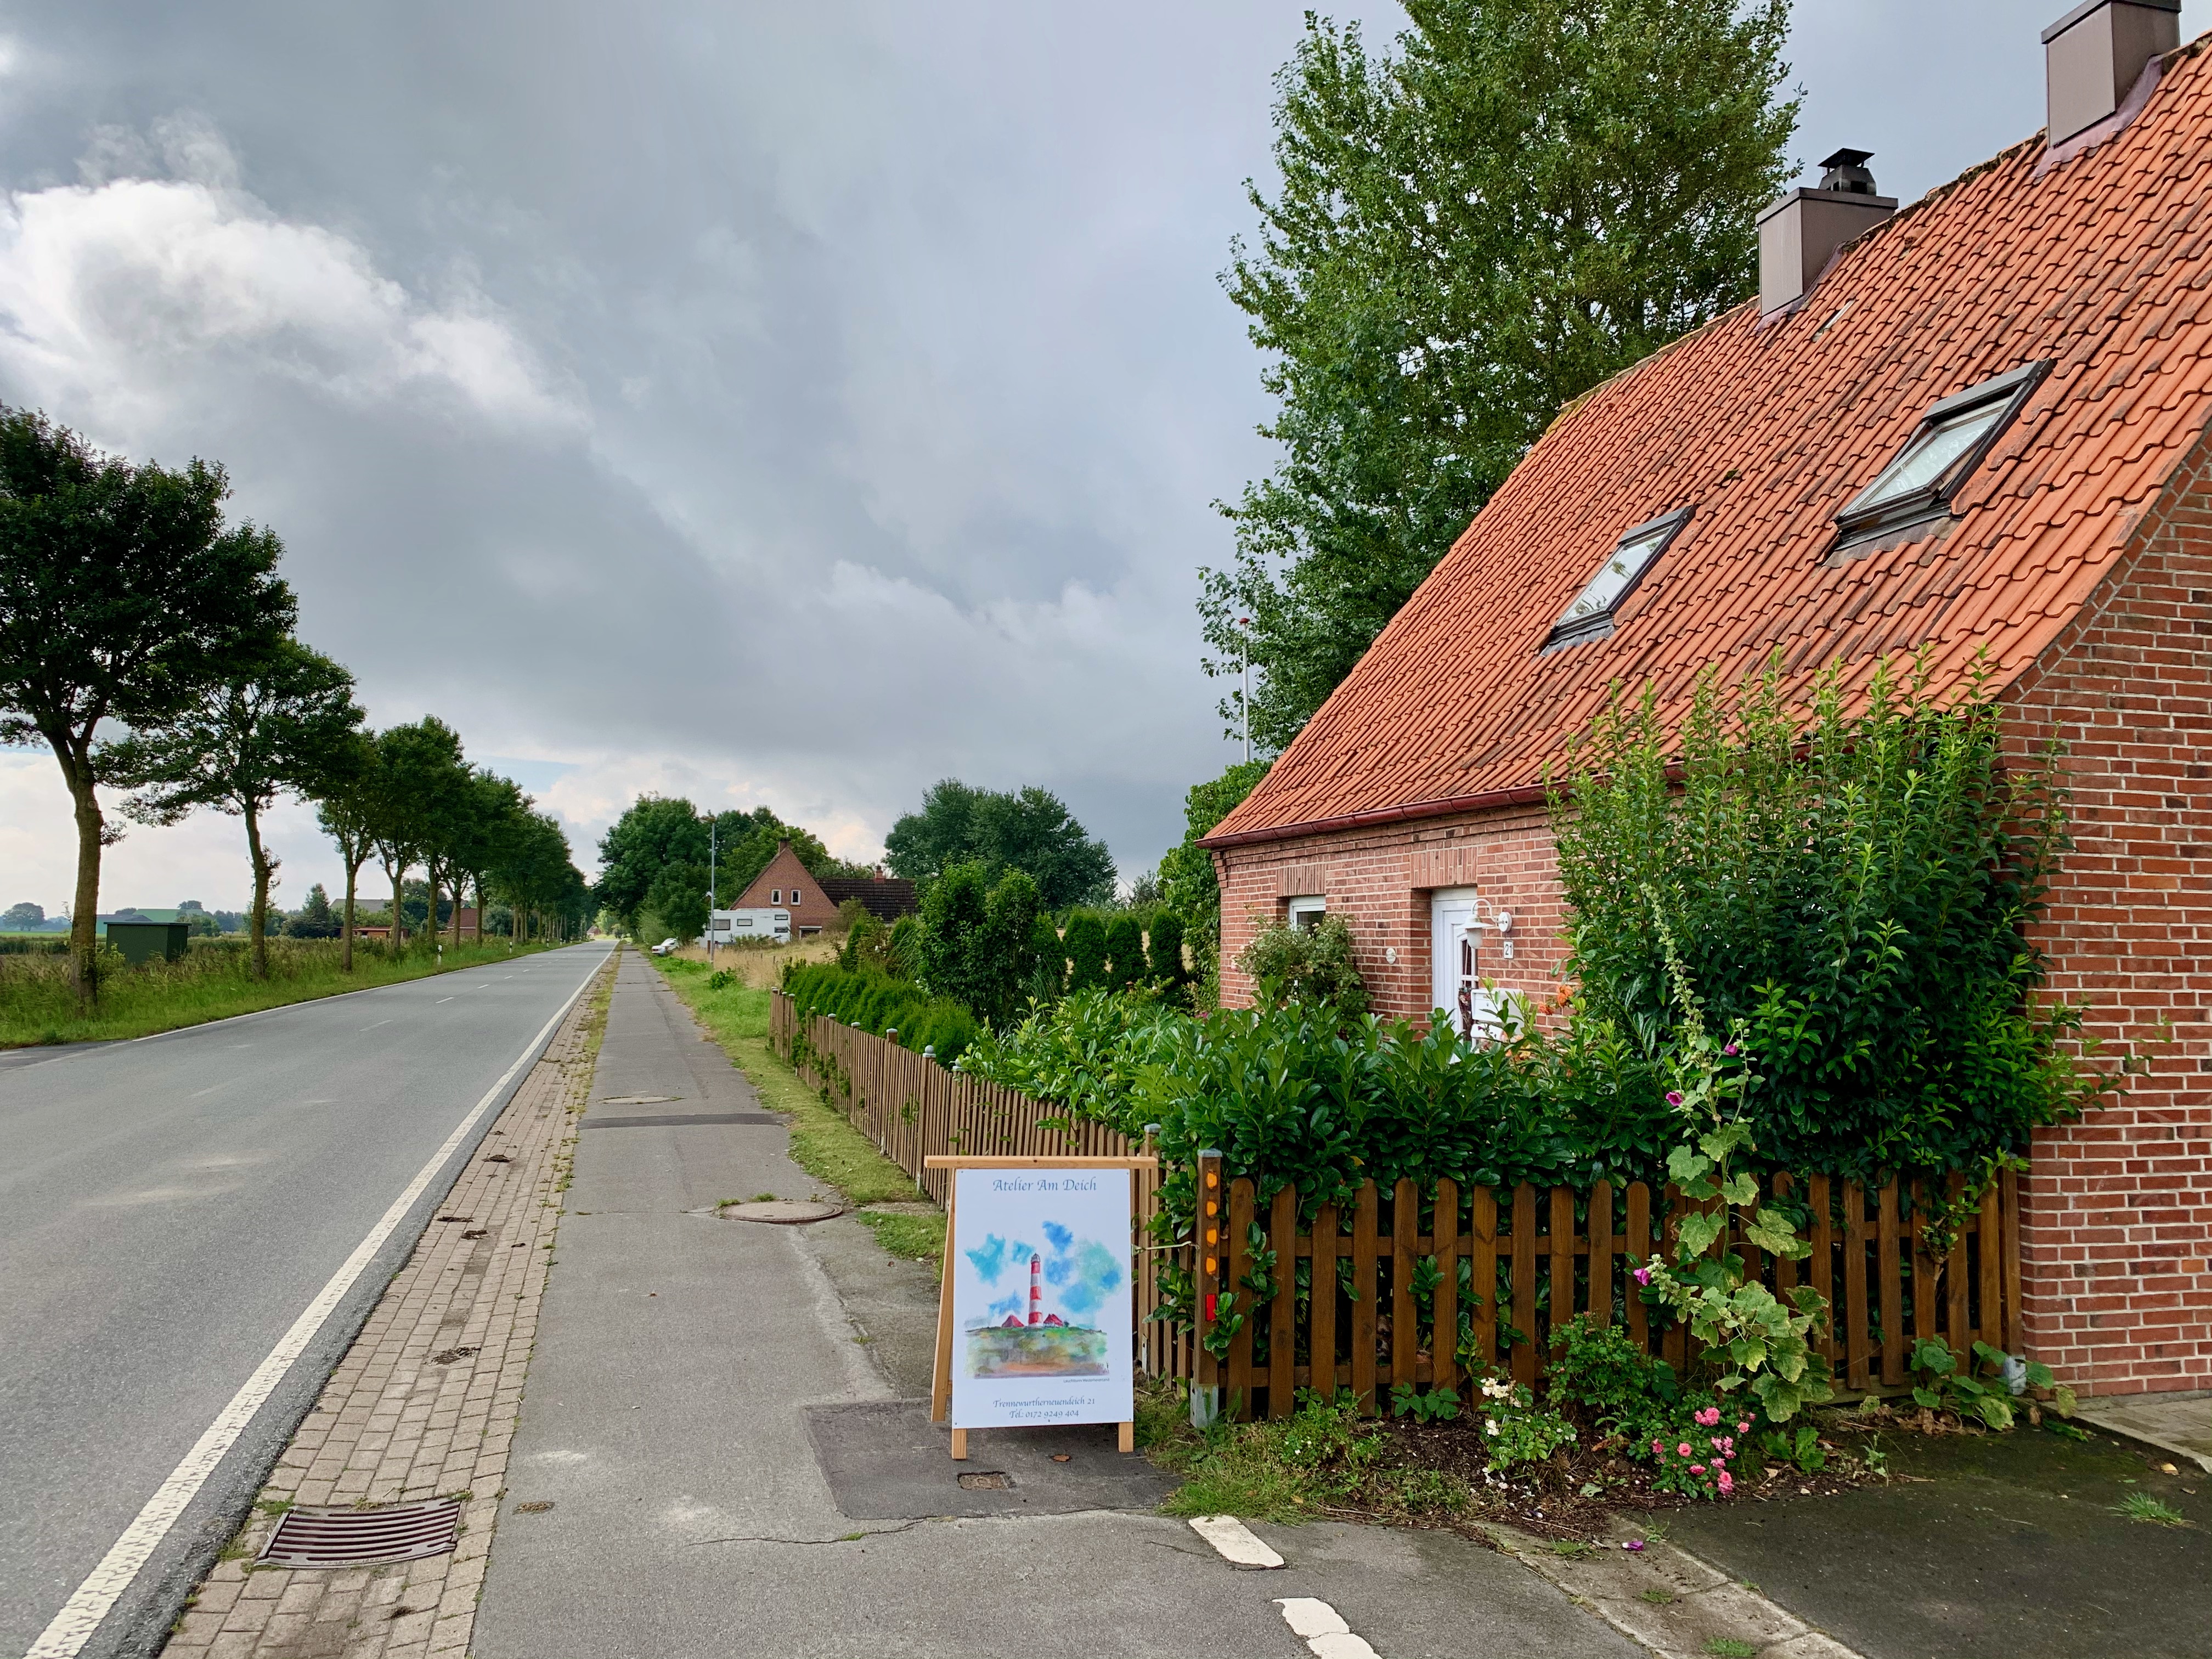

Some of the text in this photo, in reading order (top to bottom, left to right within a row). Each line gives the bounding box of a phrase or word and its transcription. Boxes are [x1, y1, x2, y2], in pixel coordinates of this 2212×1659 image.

[1505, 944, 1512, 956] 21
[993, 1176, 1097, 1192] Atelier Am Deich
[1009, 1409, 1024, 1418] Tel.:
[1044, 1410, 1063, 1419] 9249
